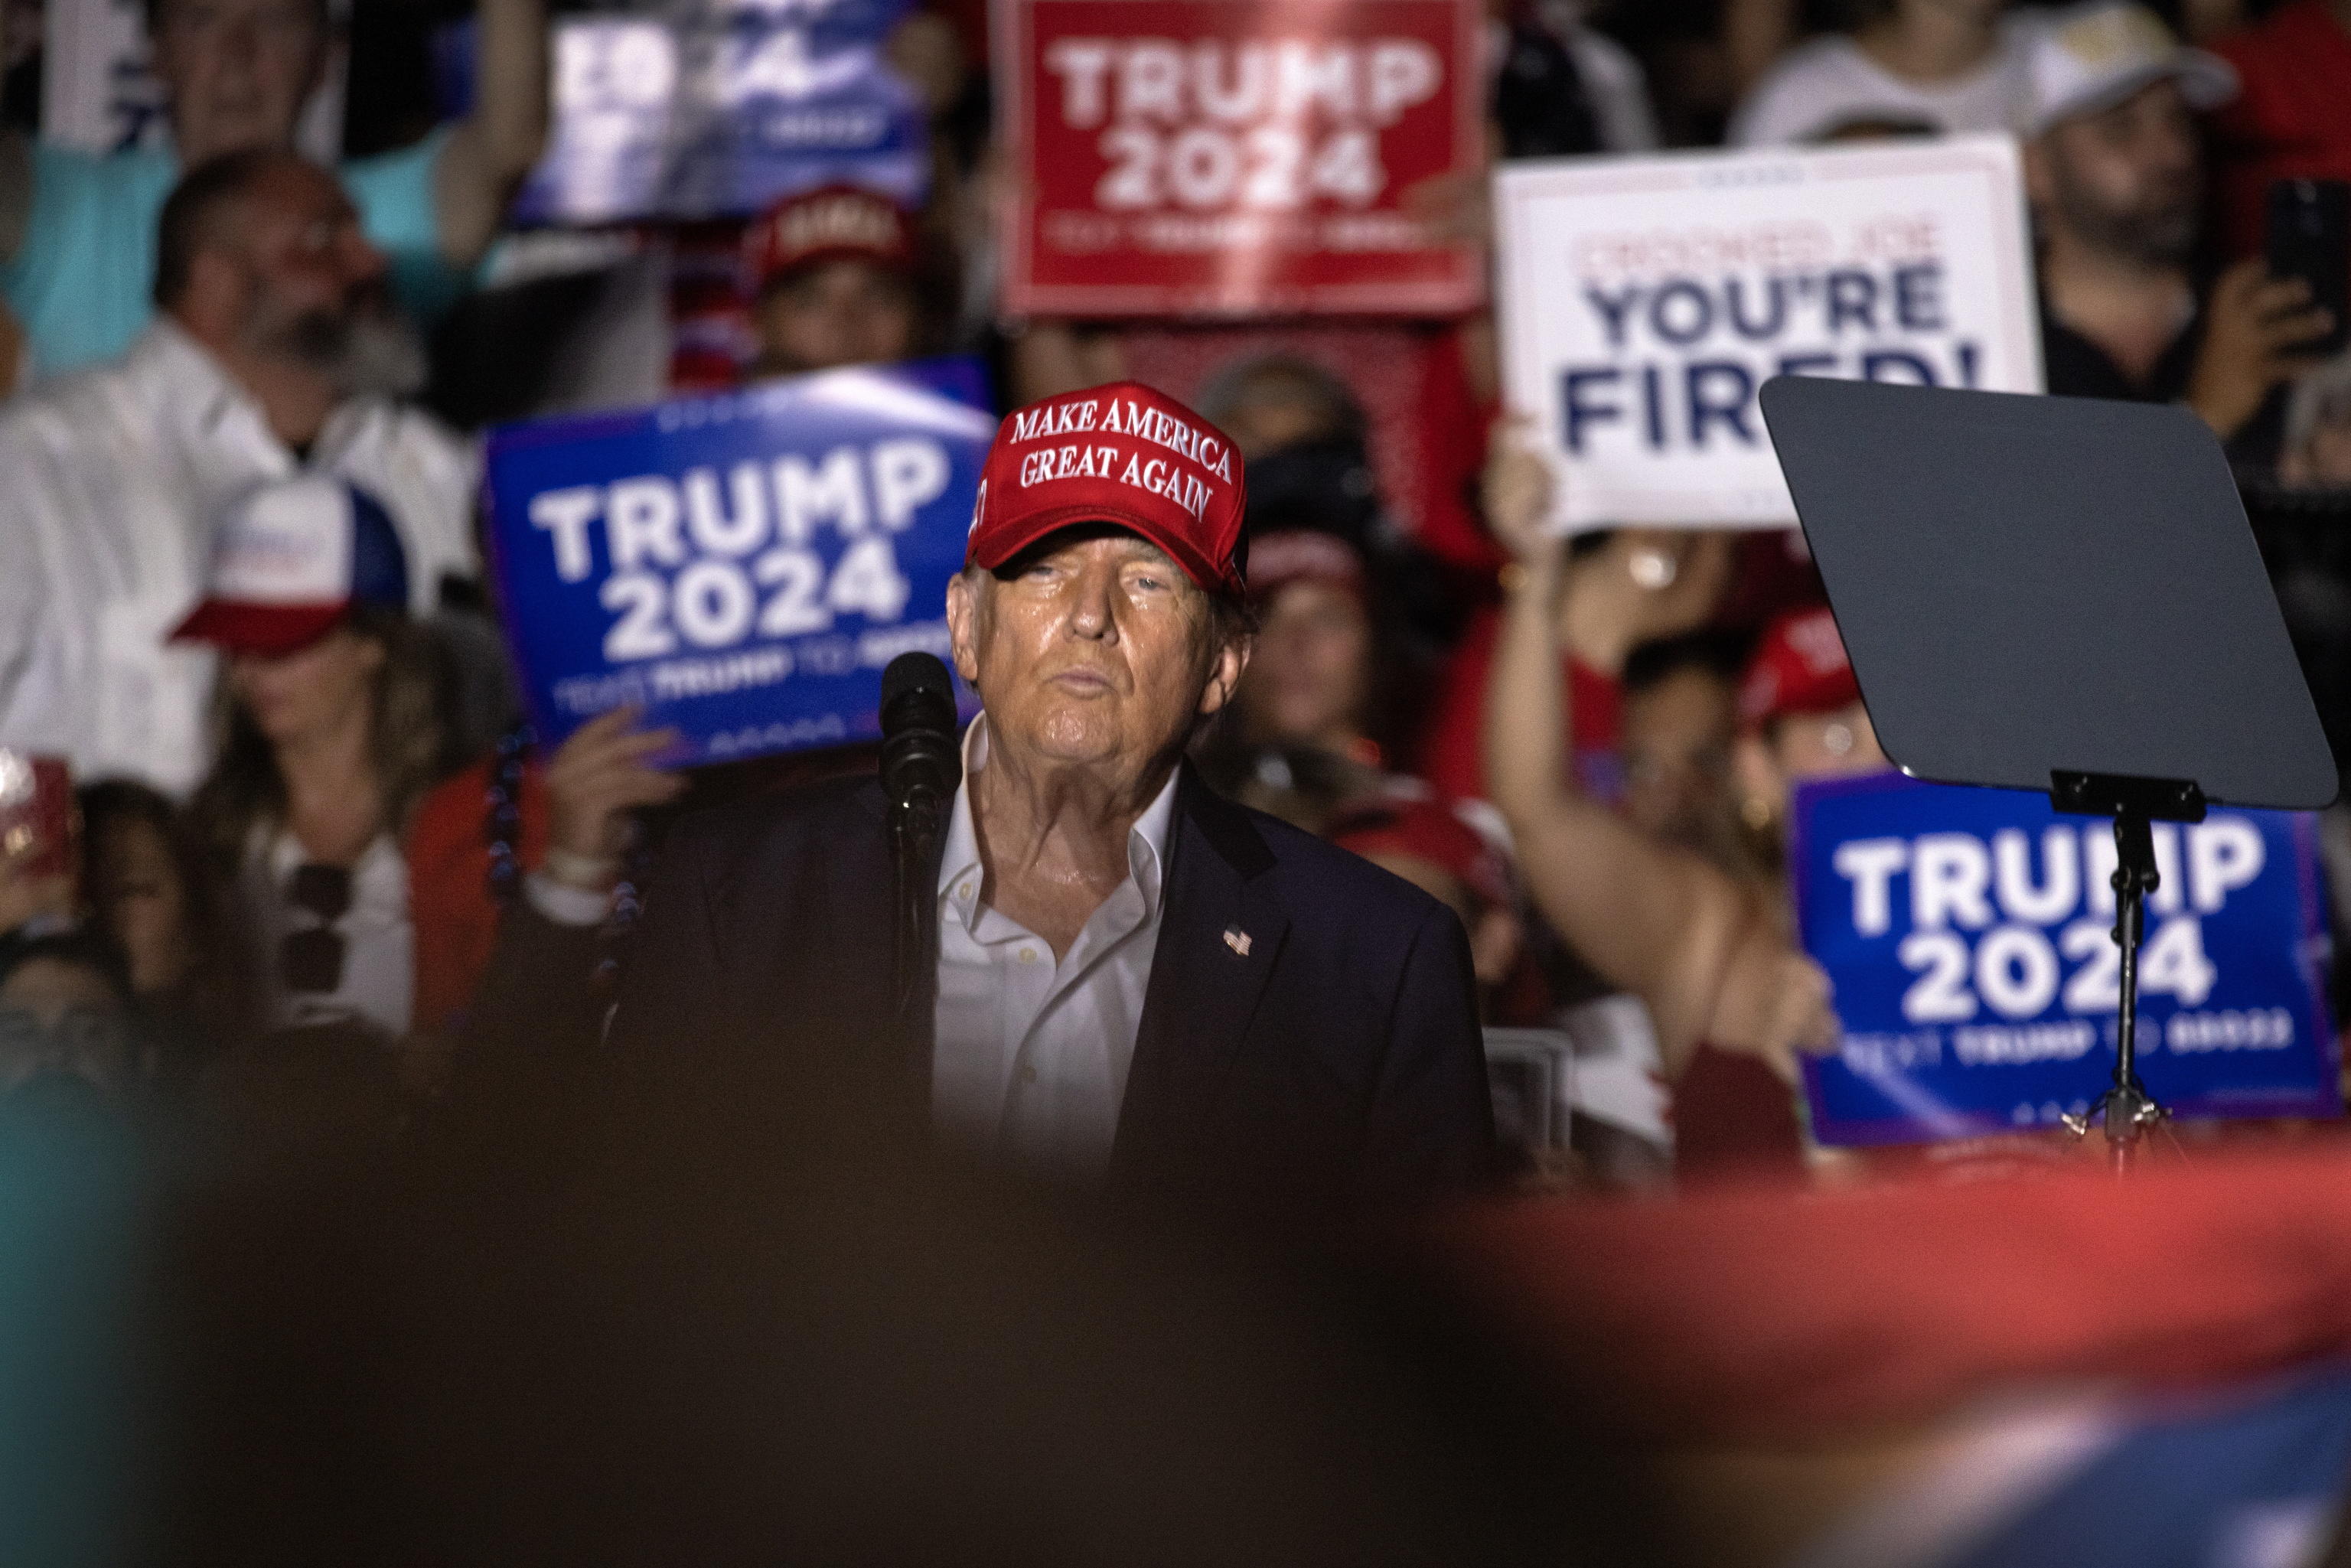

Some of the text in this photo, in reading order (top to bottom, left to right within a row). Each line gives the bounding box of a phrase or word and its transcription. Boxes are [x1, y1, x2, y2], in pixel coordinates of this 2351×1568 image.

[1045, 37, 1443, 129] TRUMP
[1096, 129, 1387, 208] 2024
[1583, 257, 1947, 347] YOU'RE
[1009, 398, 1231, 485] MAKE AMERICA
[1020, 444, 1213, 523] GREAT AGAIN
[528, 441, 951, 583] TRUMP
[598, 536, 911, 663] 2024
[1832, 817, 2265, 937] TRUMP
[1896, 914, 2216, 1022] 2024
[1953, 1019, 2097, 1065] TRUMP
